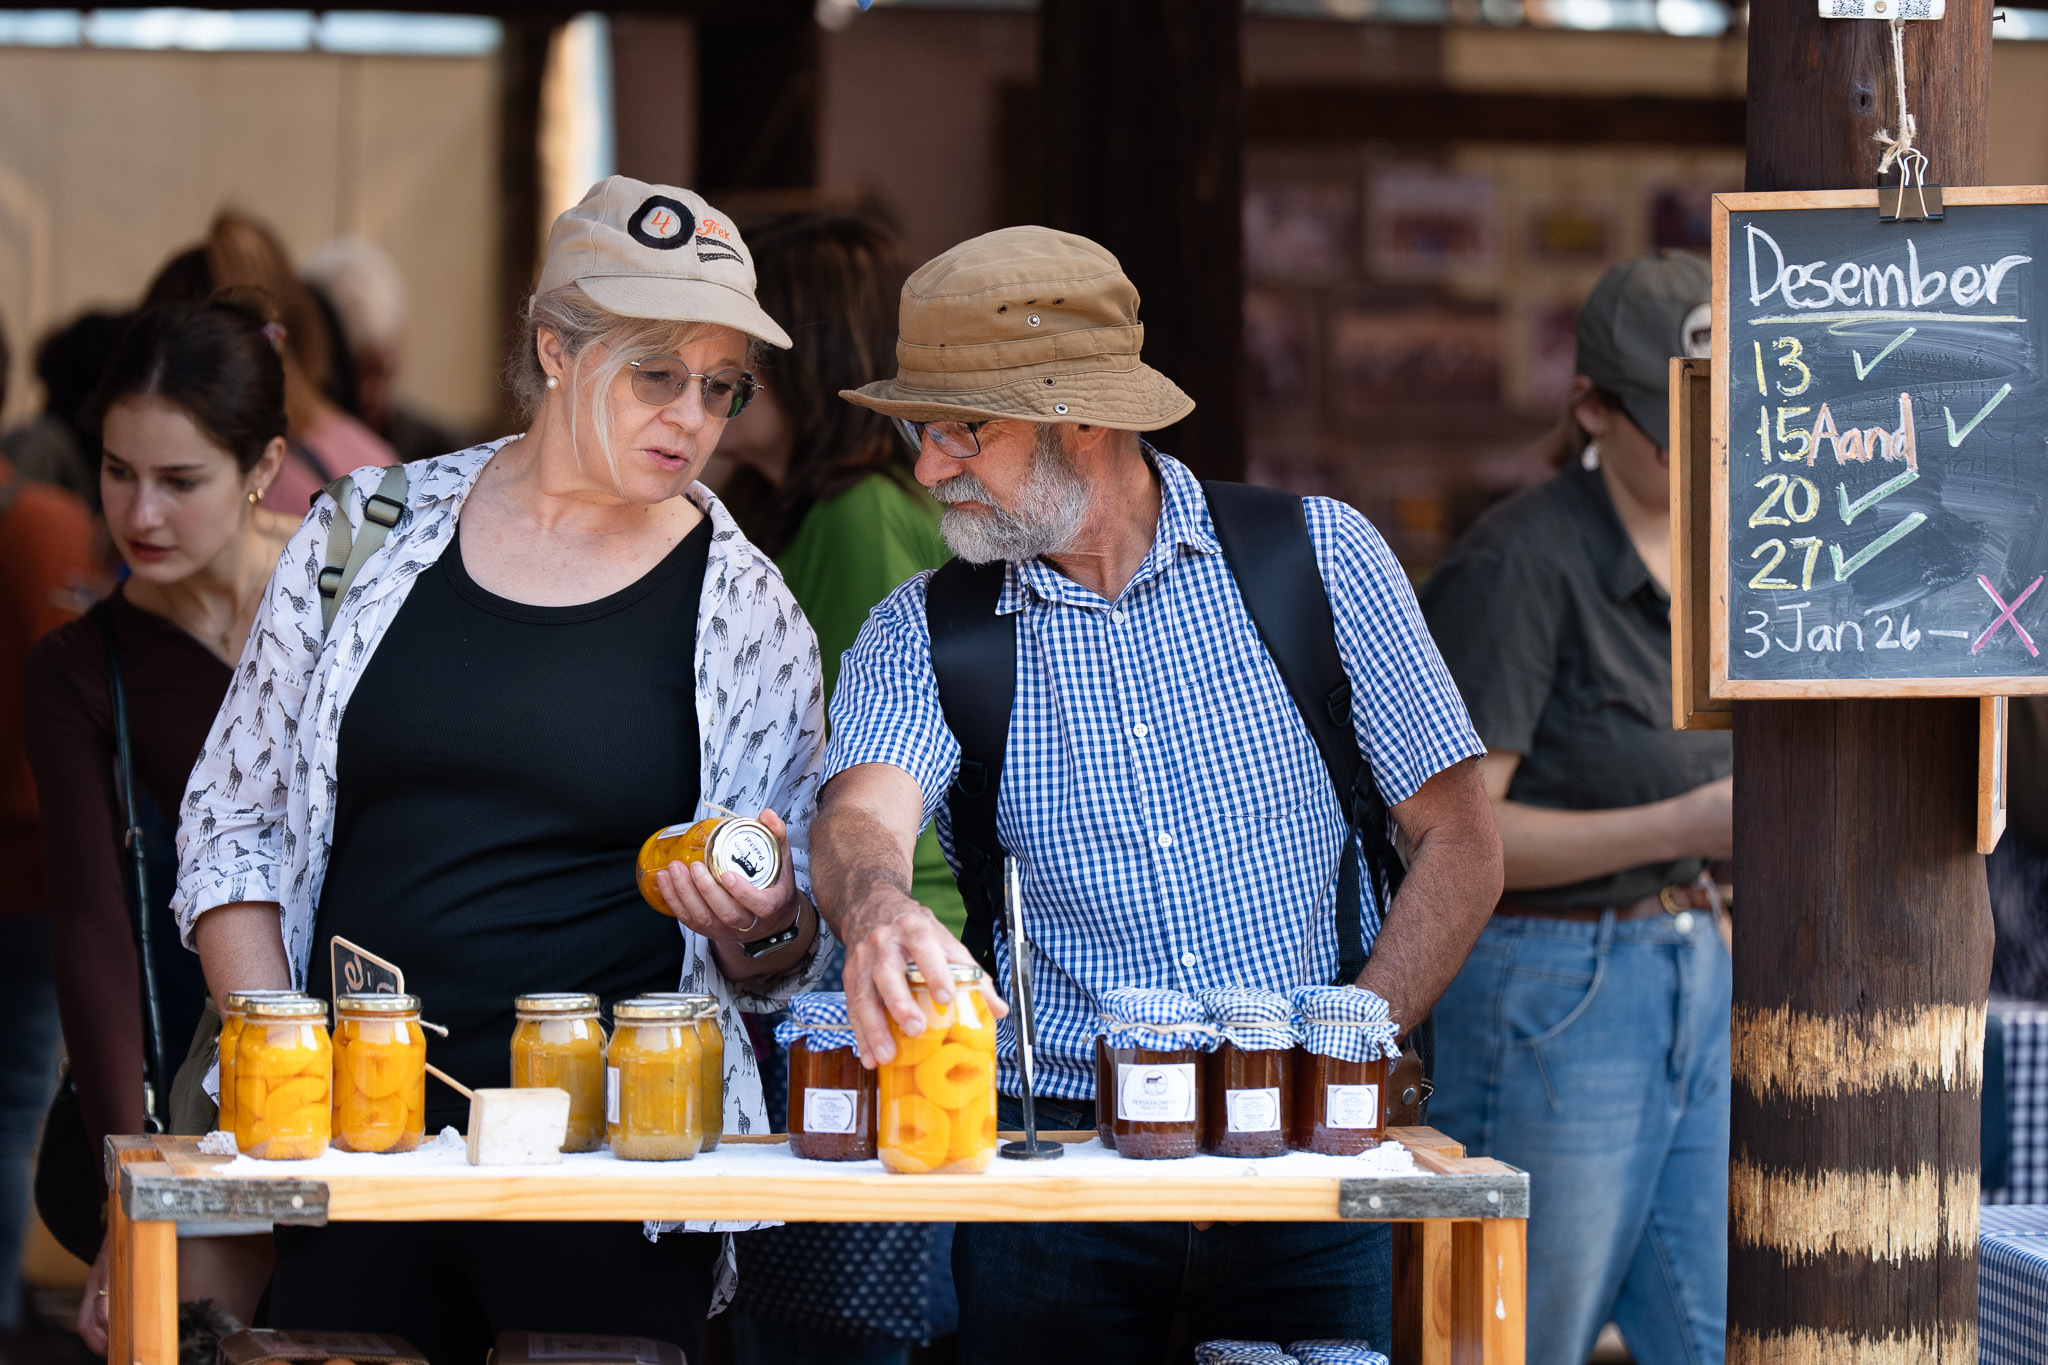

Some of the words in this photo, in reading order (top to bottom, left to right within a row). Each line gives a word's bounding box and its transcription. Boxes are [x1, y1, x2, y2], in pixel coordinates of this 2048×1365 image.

[651, 210, 672, 236] 4
[695, 219, 731, 242] Trek
[1743, 222, 2033, 308] Desember
[1753, 336, 1811, 397] 13
[1758, 405, 1812, 464] 15
[1807, 393, 1919, 473] Aand
[1748, 473, 1820, 528] 20
[1748, 536, 1823, 591] 27
[1774, 602, 1865, 653] Jan
[1874, 614, 1922, 651] 26
